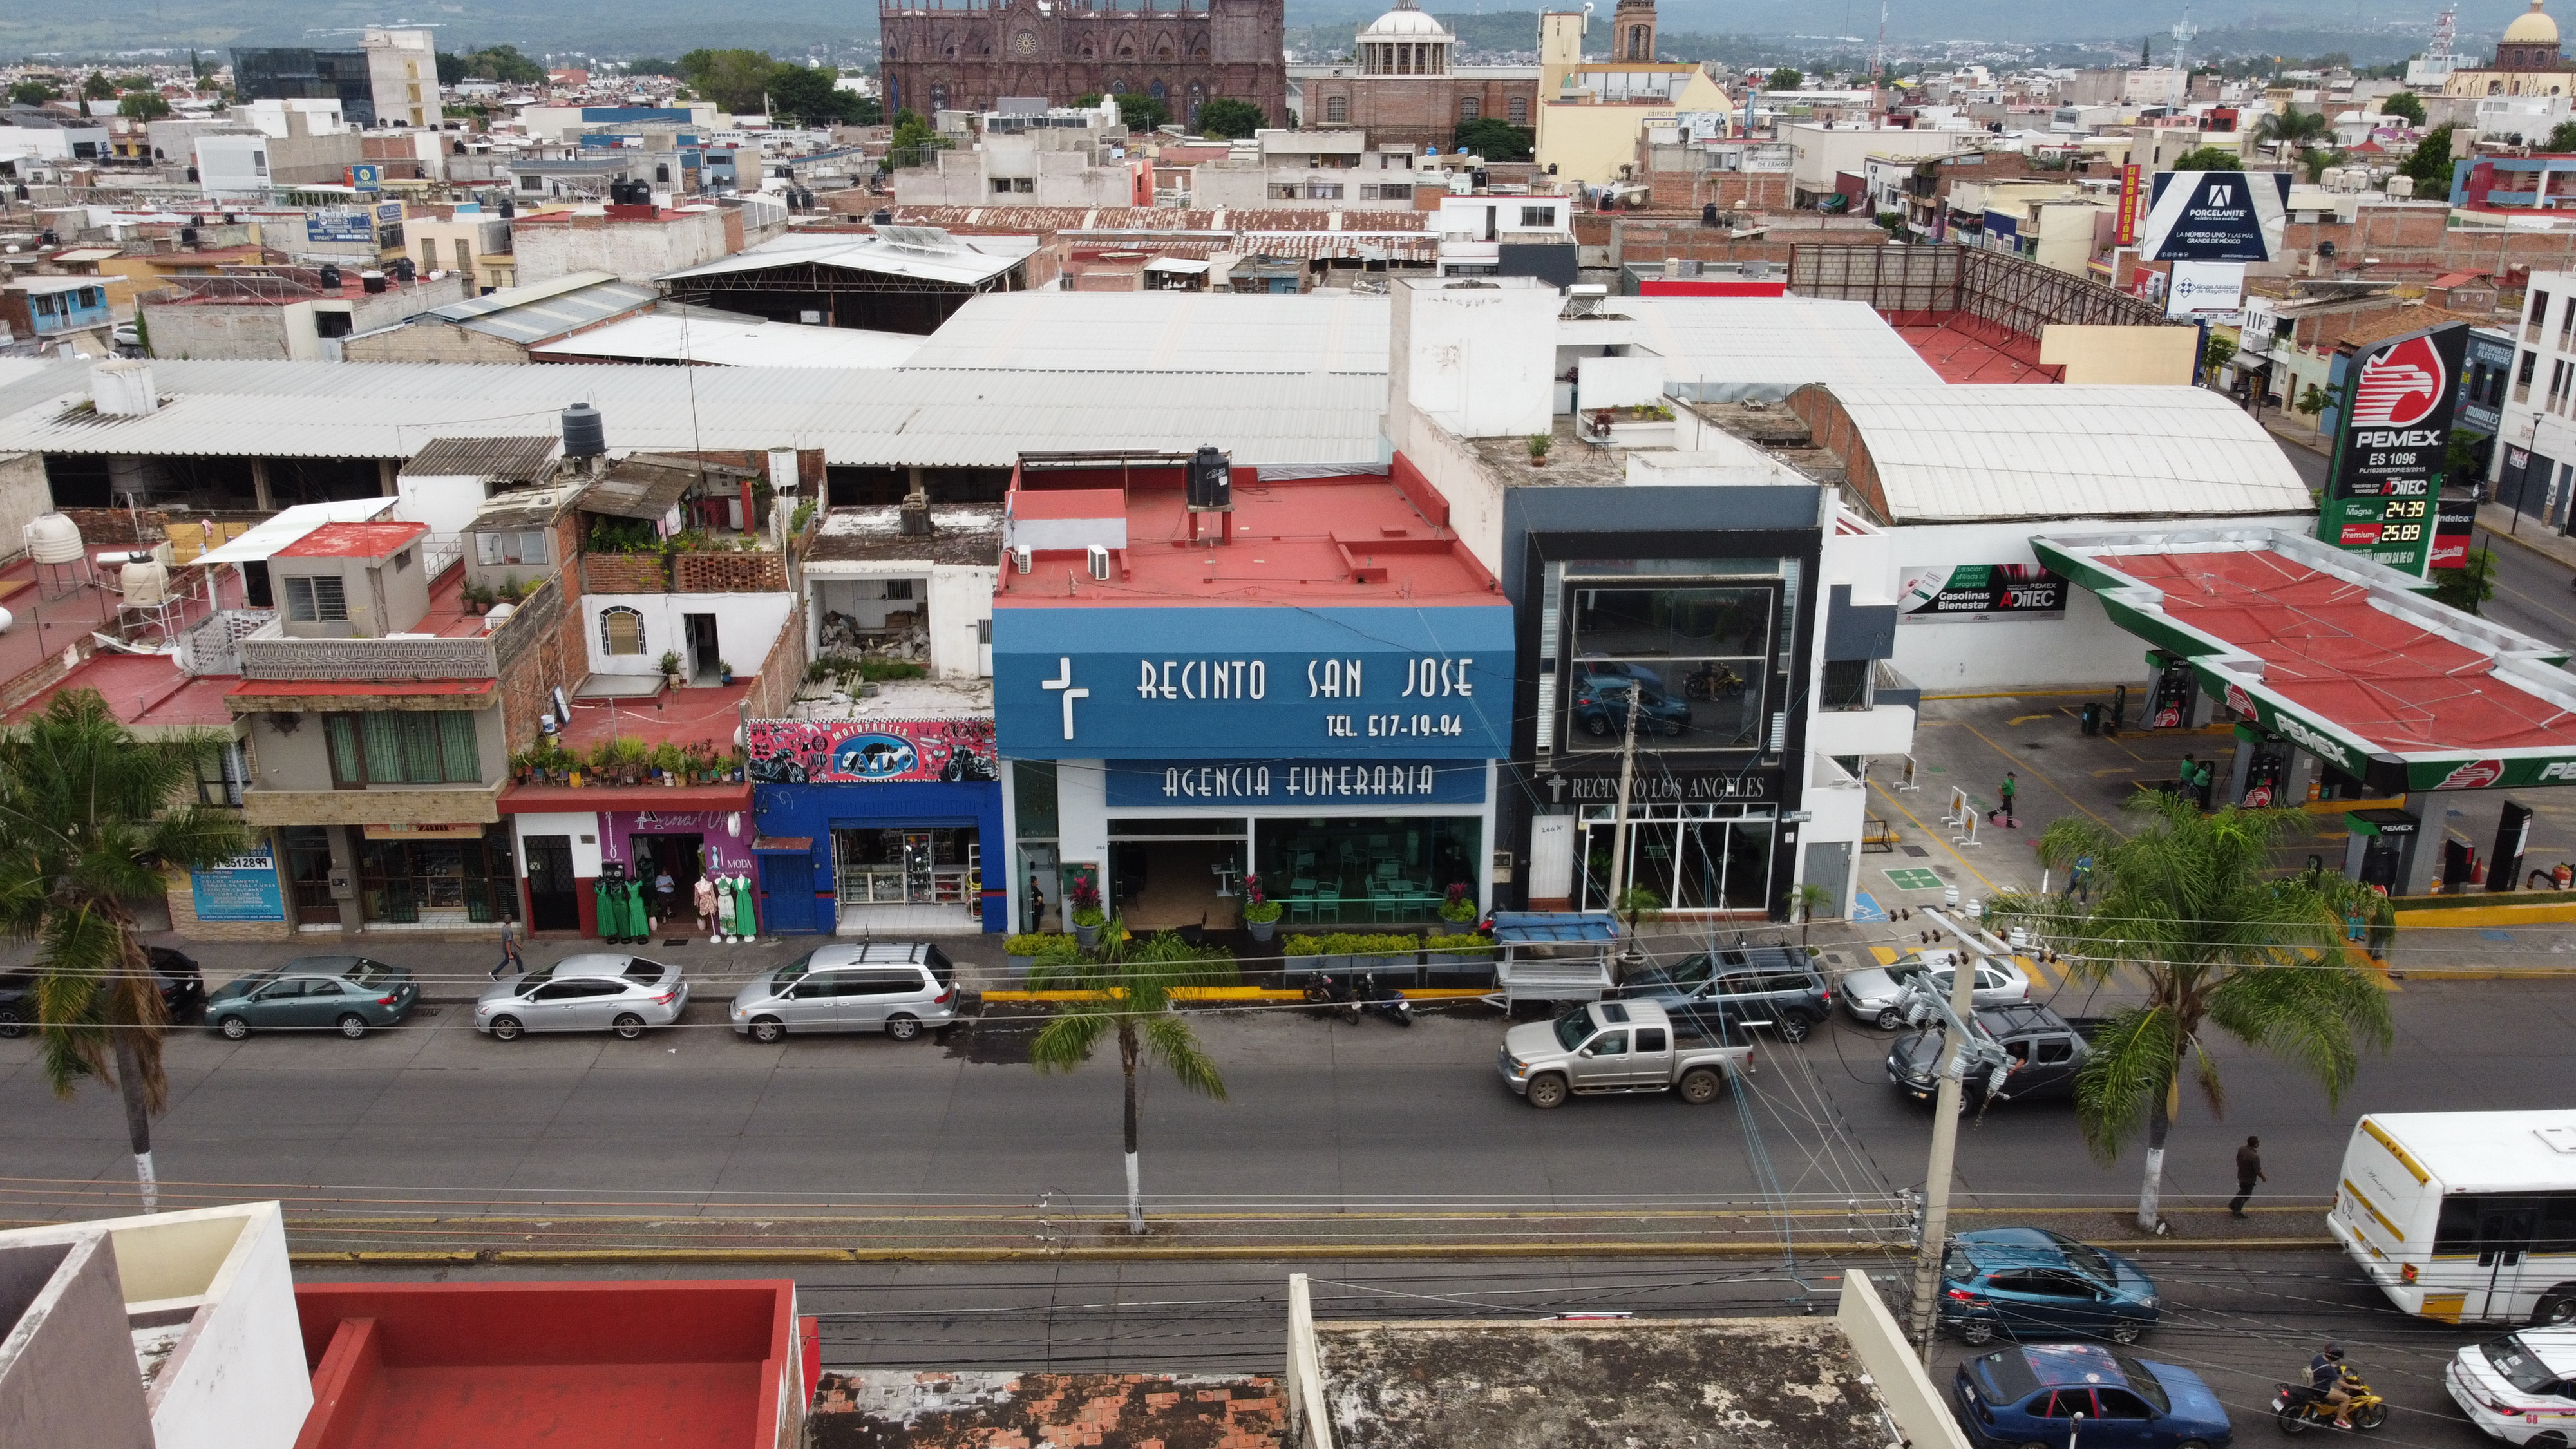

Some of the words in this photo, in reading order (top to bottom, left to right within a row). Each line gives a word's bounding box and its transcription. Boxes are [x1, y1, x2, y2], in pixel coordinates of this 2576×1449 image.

[2478, 342, 2513, 358] AUTOPARTES
[2465, 405, 2500, 425] MORALES
[2356, 430, 2441, 448] PEMEX
[2369, 453, 2386, 465] ES
[2389, 453, 2416, 464] 1096
[2346, 508, 2372, 516] Magna
[2386, 501, 2425, 518] 24.39
[2382, 524, 2421, 541] 25.89
[2407, 551, 2415, 563] CV
[1938, 591, 1990, 601] Gasolinas
[1938, 601, 1989, 610] Bienestar
[1137, 660, 1265, 699] RECINTO
[1308, 659, 1361, 698] SAN
[1402, 658, 1472, 697] JOSE
[832, 723, 908, 741] MOTOPARTES
[1327, 715, 1358, 737] TEL.
[1368, 714, 1462, 737] 517-19-94
[2275, 712, 2349, 768] PEMEX
[829, 753, 920, 773] LALO
[1162, 766, 1269, 797] AGENCIA
[1286, 765, 1433, 797] FUNERARIA
[1571, 778, 1647, 799] RECINO
[1651, 777, 1682, 798] LOS
[1688, 777, 1765, 798] ANGELES
[727, 859, 752, 869] MODA
[2526, 1414, 2538, 1424] 68
